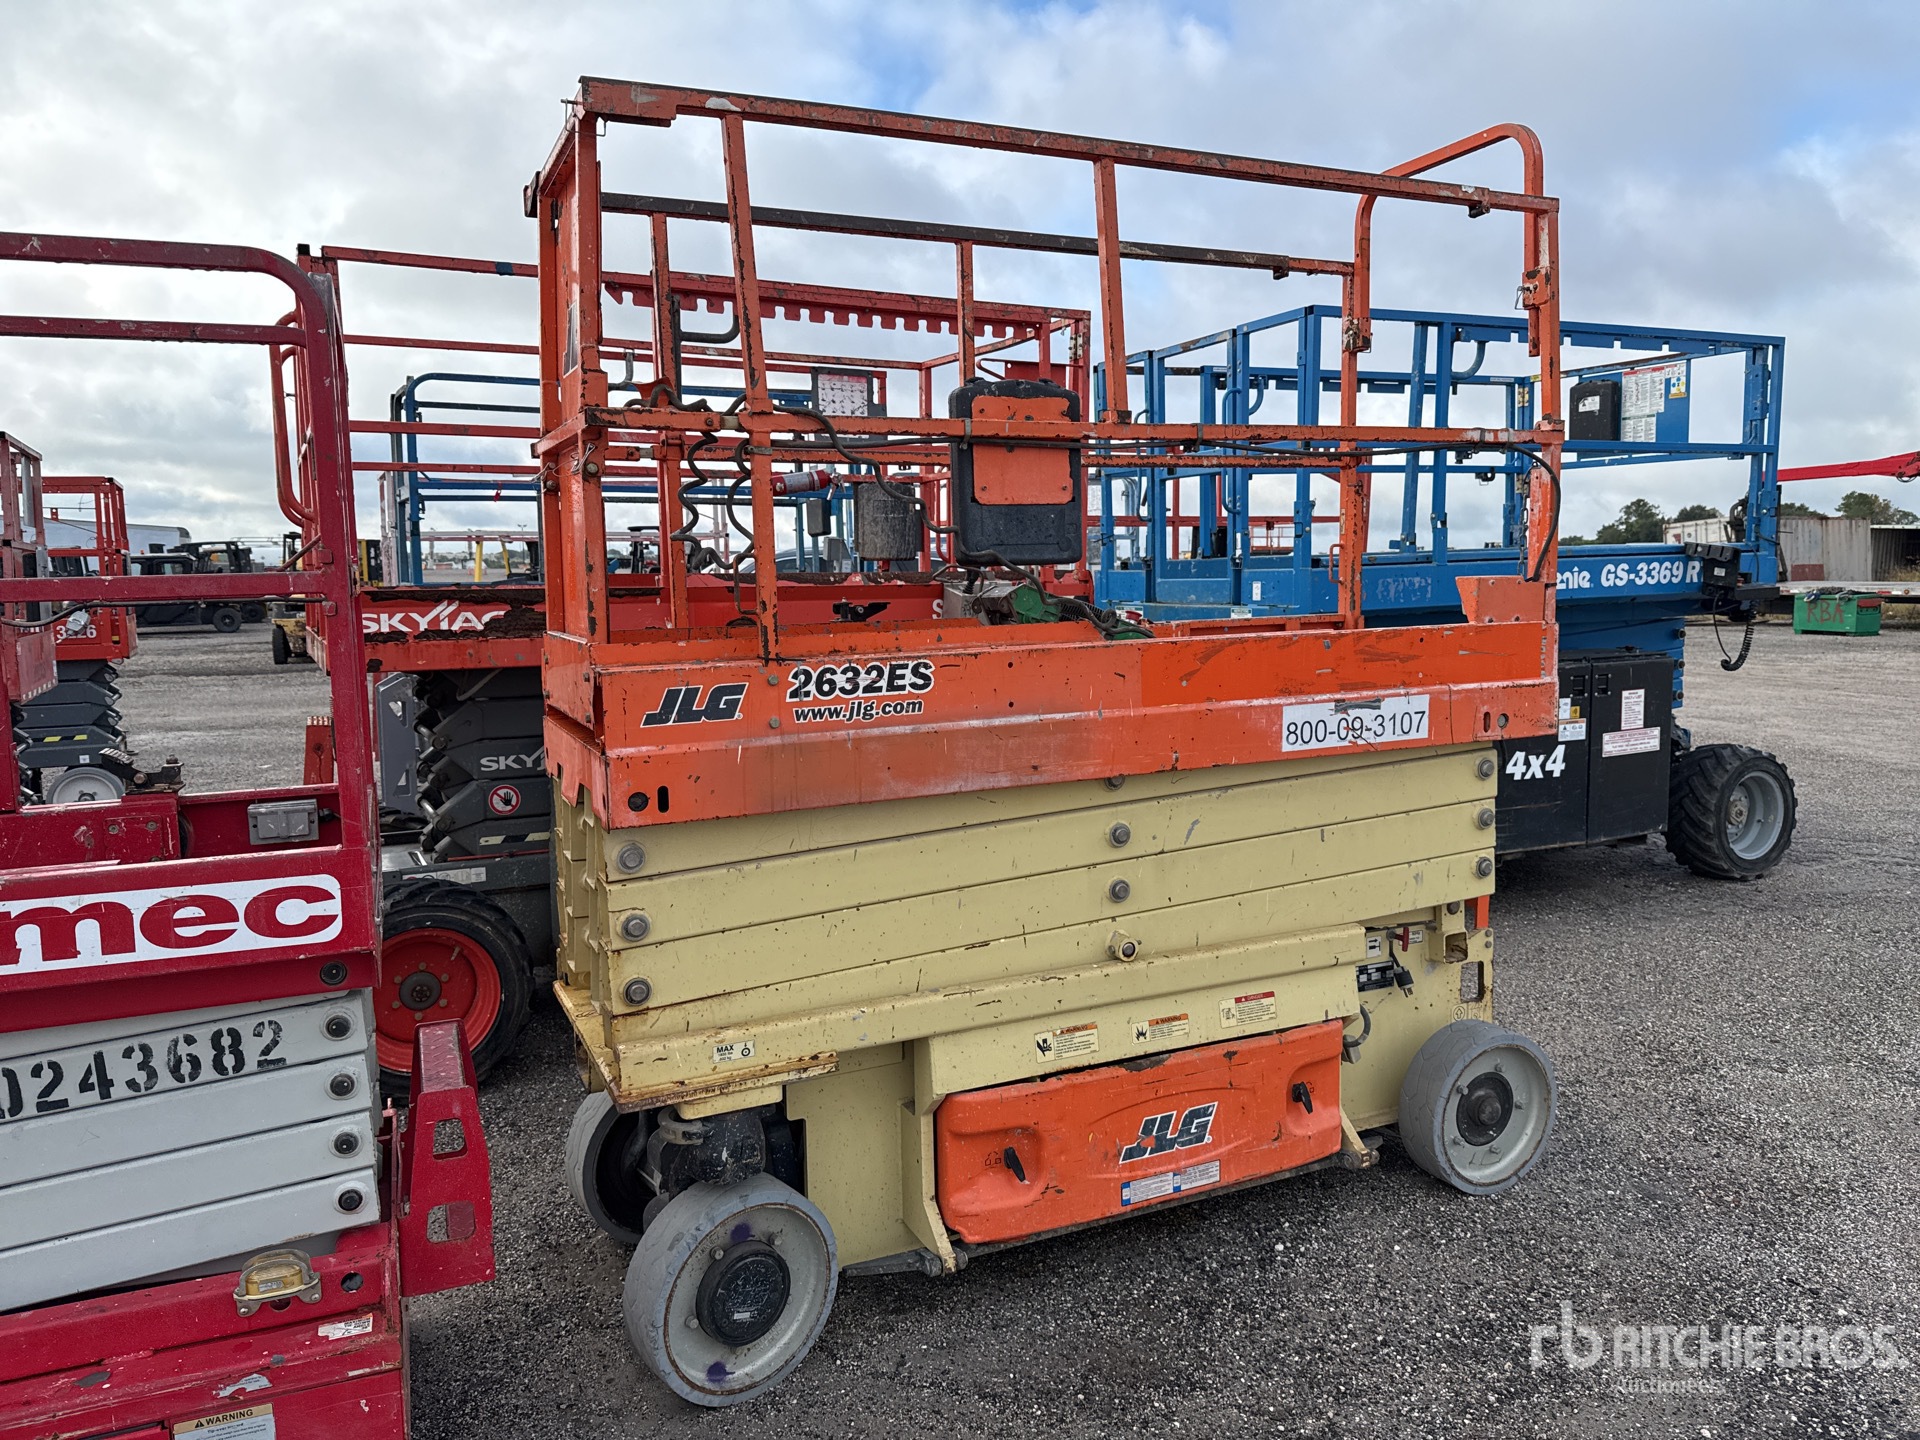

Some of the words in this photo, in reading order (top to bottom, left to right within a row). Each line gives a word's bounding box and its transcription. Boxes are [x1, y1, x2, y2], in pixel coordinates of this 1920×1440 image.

[1556, 566, 1591, 590] enie
[1600, 561, 1684, 588] GS-3369
[1685, 560, 1703, 583] R
[56, 624, 97, 640] 36
[787, 660, 935, 703] 2632ES
[641, 683, 748, 728] JLG
[793, 698, 923, 723] www.jlg.com
[1285, 710, 1427, 746] 800-09-3107
[480, 747, 545, 772] SKYJ
[1505, 744, 1566, 781] 4x4
[716, 1044, 735, 1053] MAX
[1119, 1101, 1218, 1165] JLG
[205, 1408, 254, 1426] WARNING
